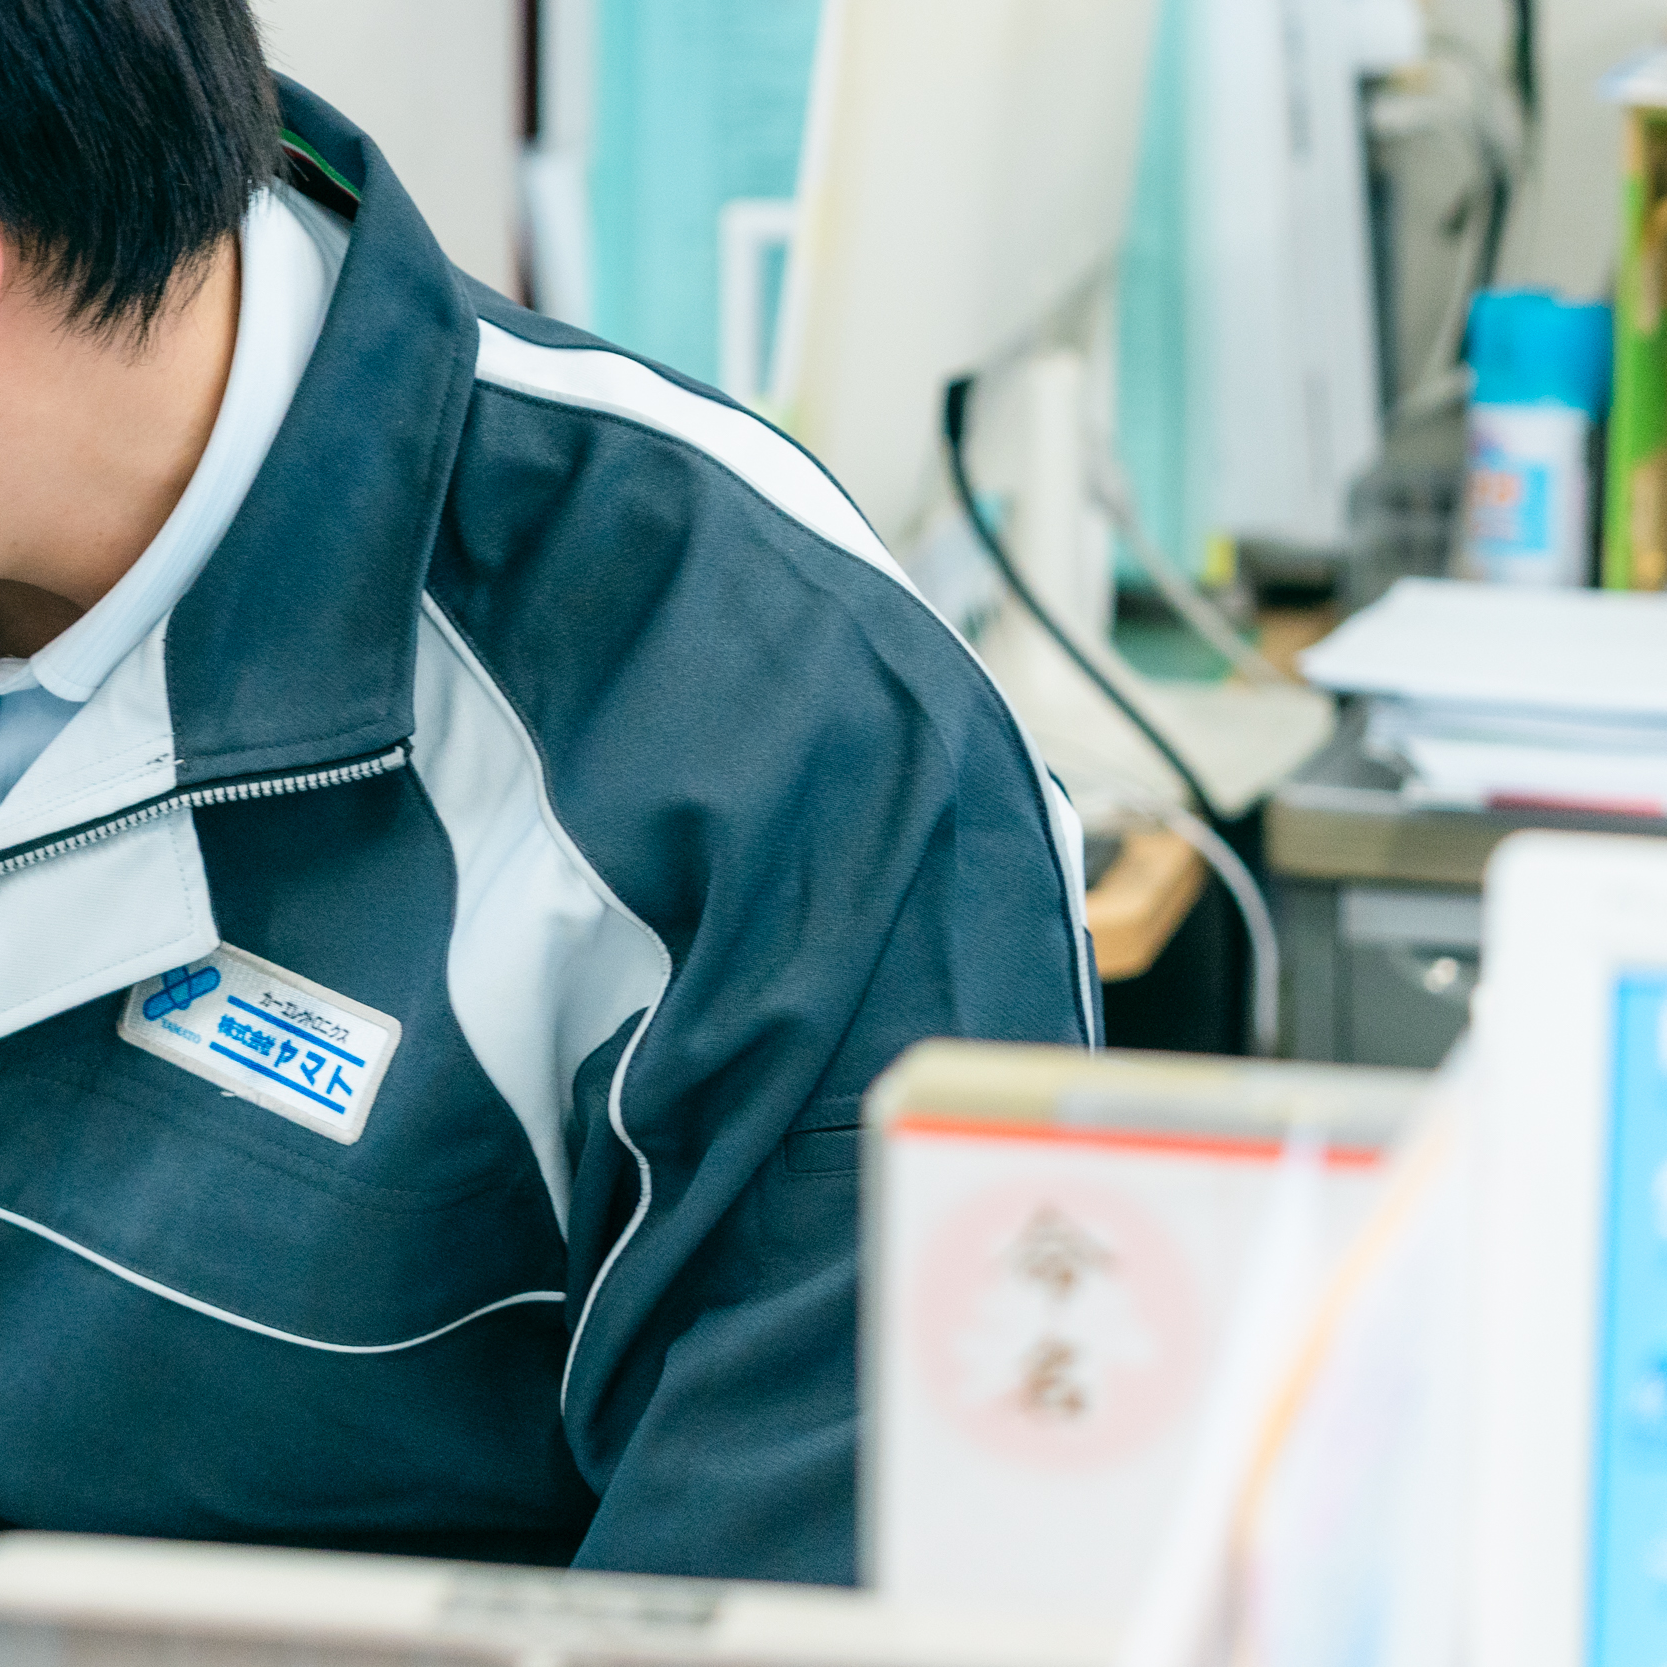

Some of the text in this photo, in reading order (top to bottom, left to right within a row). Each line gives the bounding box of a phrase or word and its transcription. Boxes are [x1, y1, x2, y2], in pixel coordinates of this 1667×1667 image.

[218, 1013, 354, 1097] 株式会社ヤマト
